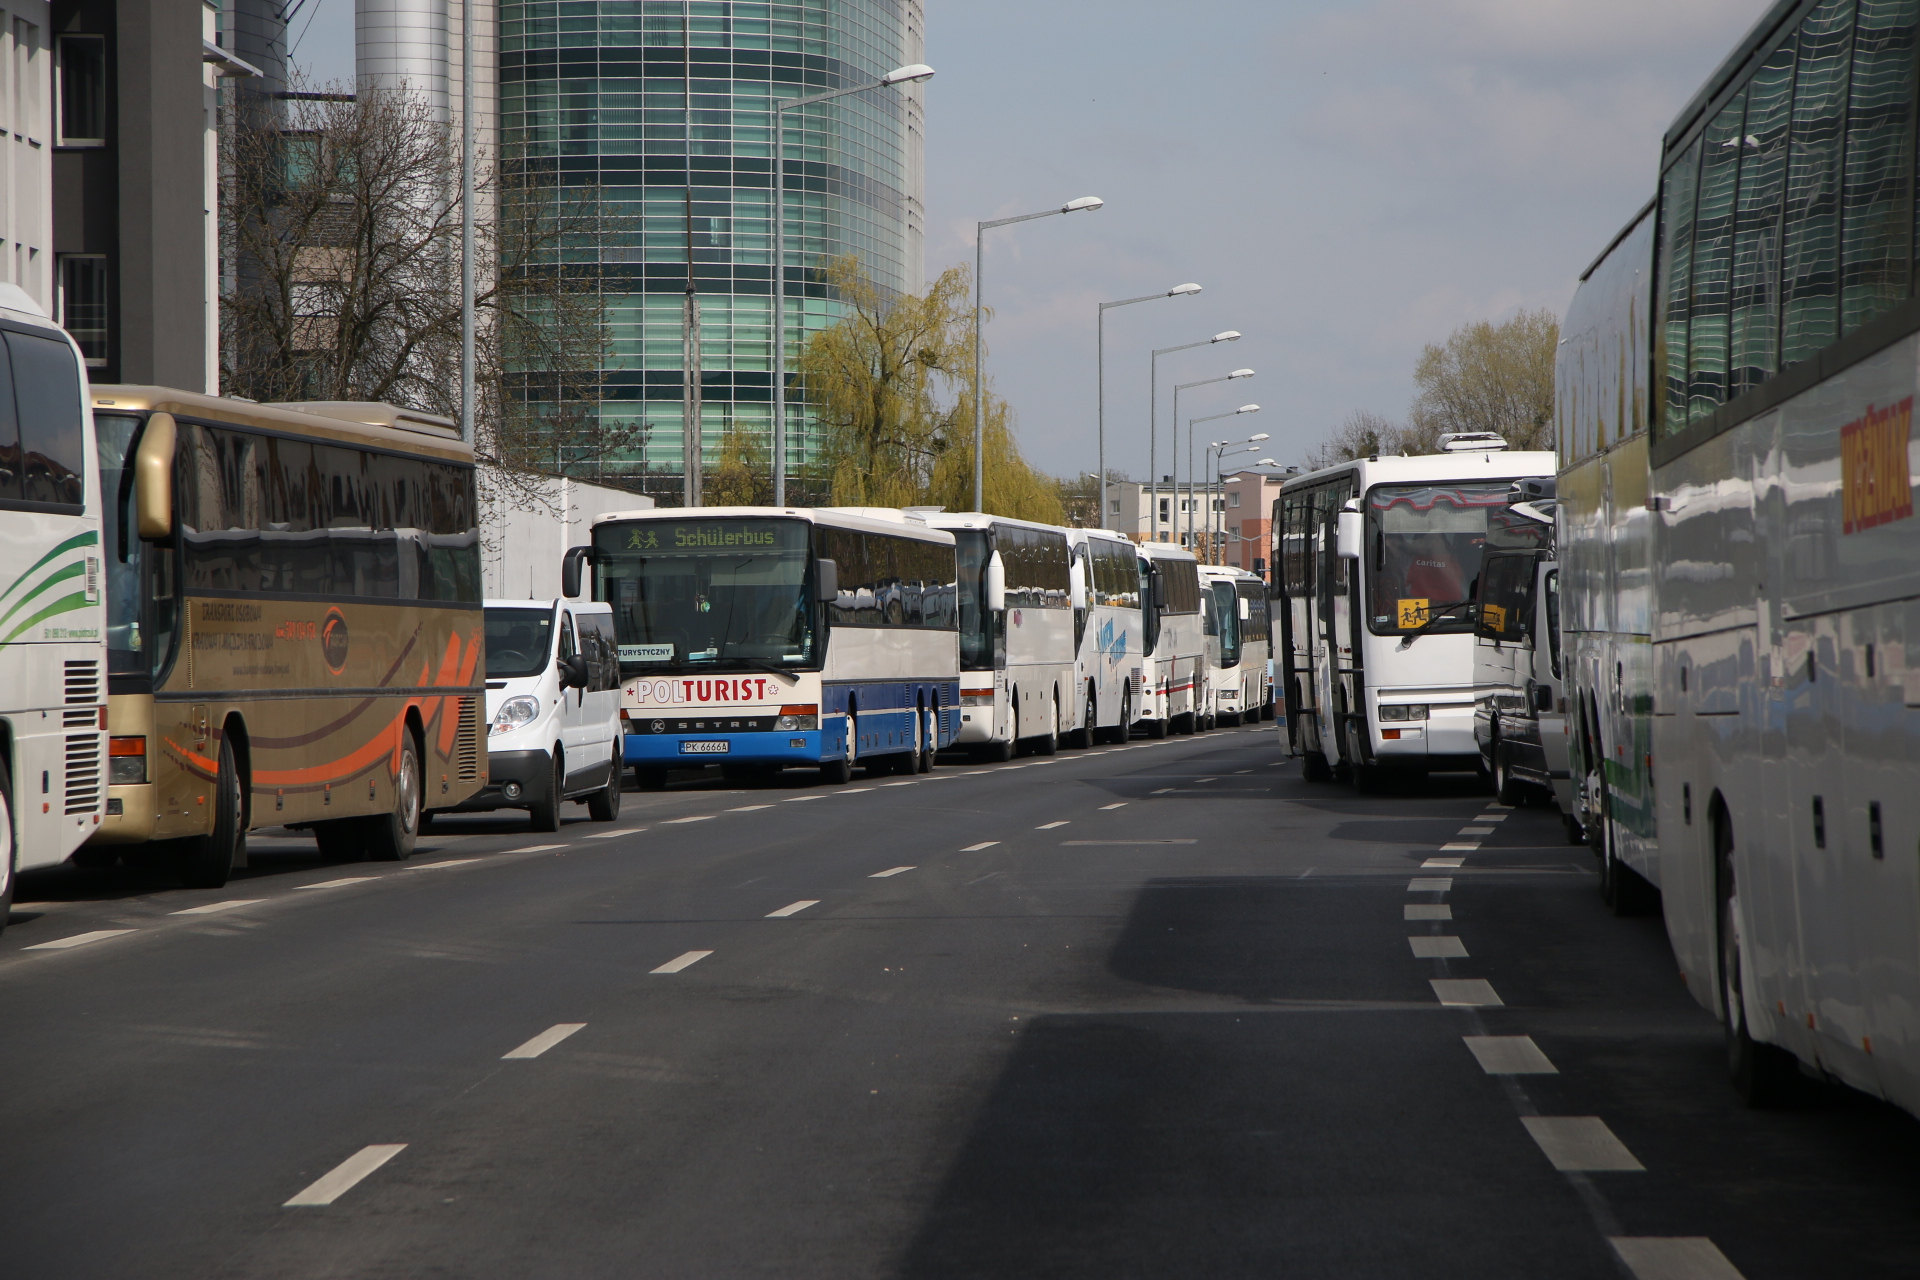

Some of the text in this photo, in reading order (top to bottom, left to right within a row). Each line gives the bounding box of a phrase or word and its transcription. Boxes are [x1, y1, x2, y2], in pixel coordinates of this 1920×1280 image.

[1840, 394, 1914, 535] WOŹNIAK
[675, 525, 775, 547] Schülerbus
[1416, 559, 1446, 568] caritas
[618, 648, 671, 657] TURYSTYCZNY
[636, 678, 767, 704] POLTURIST
[678, 721, 758, 729] SETRA
[685, 742, 698, 752] PK
[700, 742, 727, 751] 6666A
